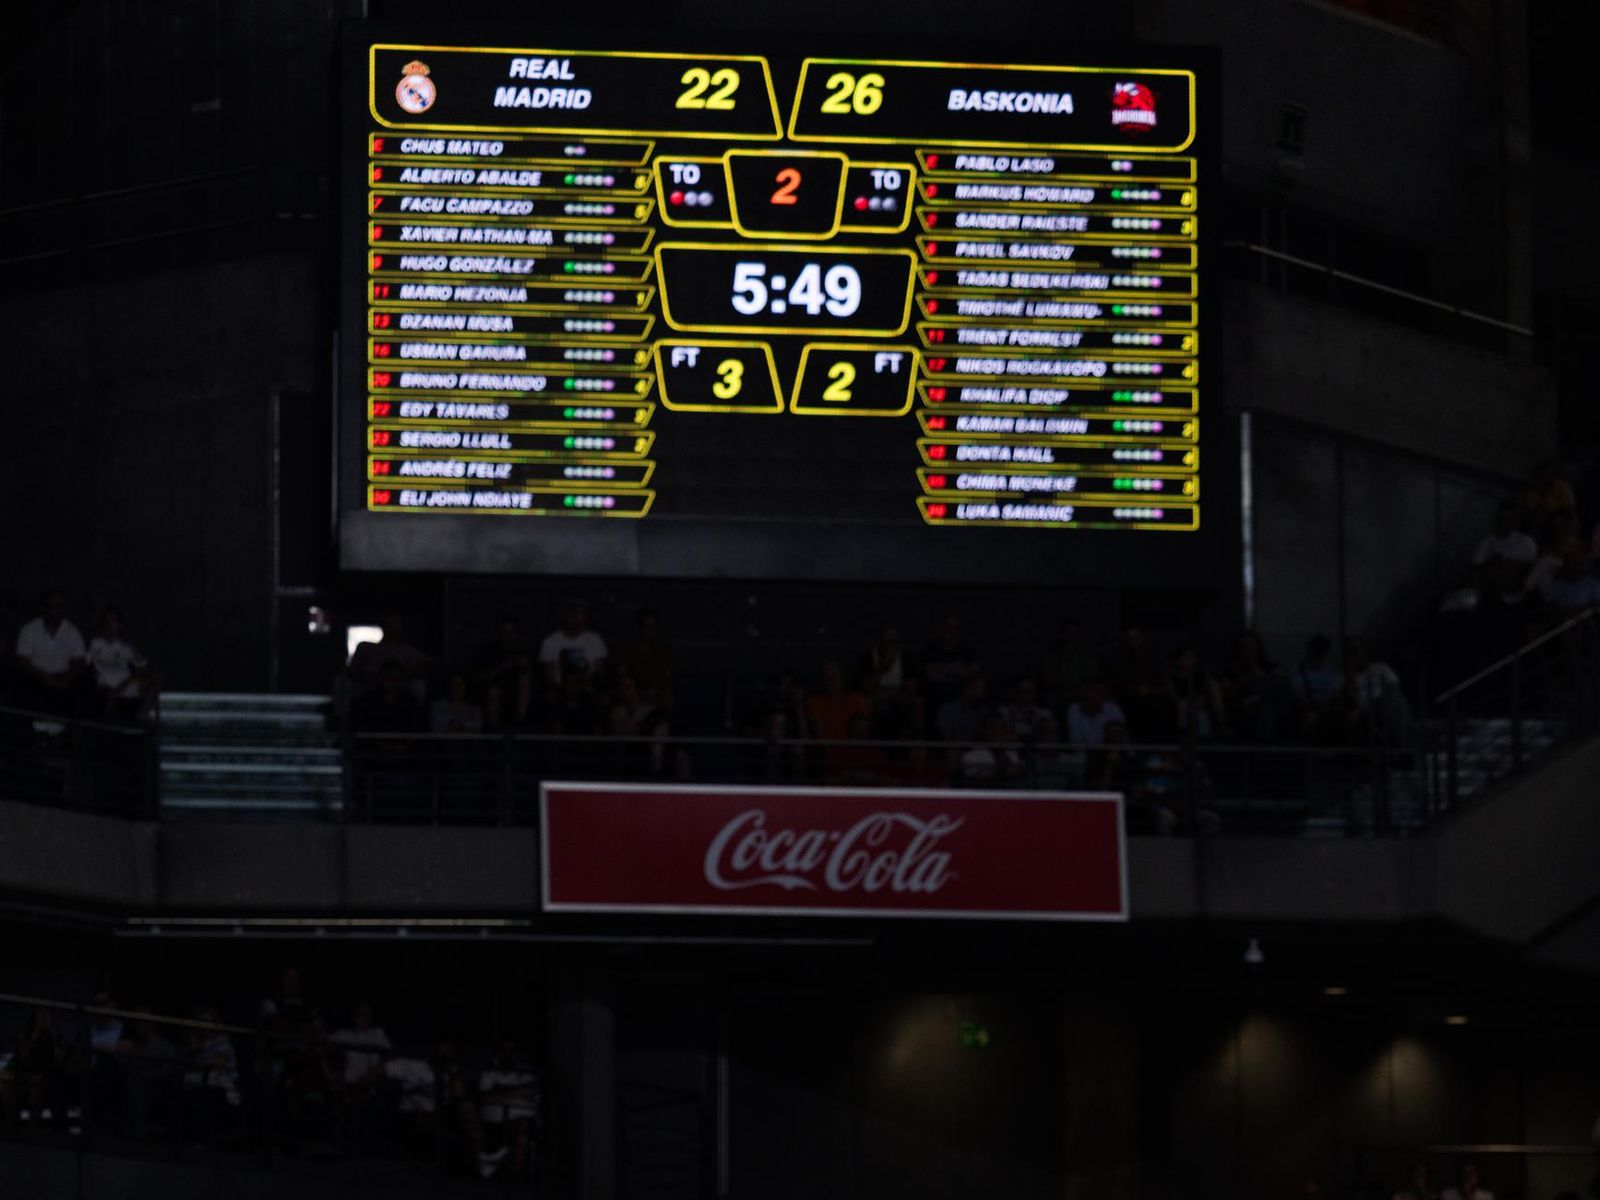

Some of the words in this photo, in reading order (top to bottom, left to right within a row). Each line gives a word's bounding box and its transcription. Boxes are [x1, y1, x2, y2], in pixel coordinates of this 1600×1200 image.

[510, 59, 574, 80] REAL
[494, 87, 592, 109] MADRID
[675, 68, 740, 110] 22
[821, 73, 885, 115] 26
[947, 90, 1074, 114] BASKONIA
[401, 139, 445, 154] CHUS
[447, 141, 503, 155] MATEO
[670, 164, 700, 184] TO
[870, 170, 901, 190] TO
[771, 168, 801, 204] 2
[732, 262, 861, 317] 5:49
[671, 347, 700, 367] FT
[874, 353, 903, 373] FT
[713, 359, 744, 399] 3
[823, 362, 856, 401] 2
